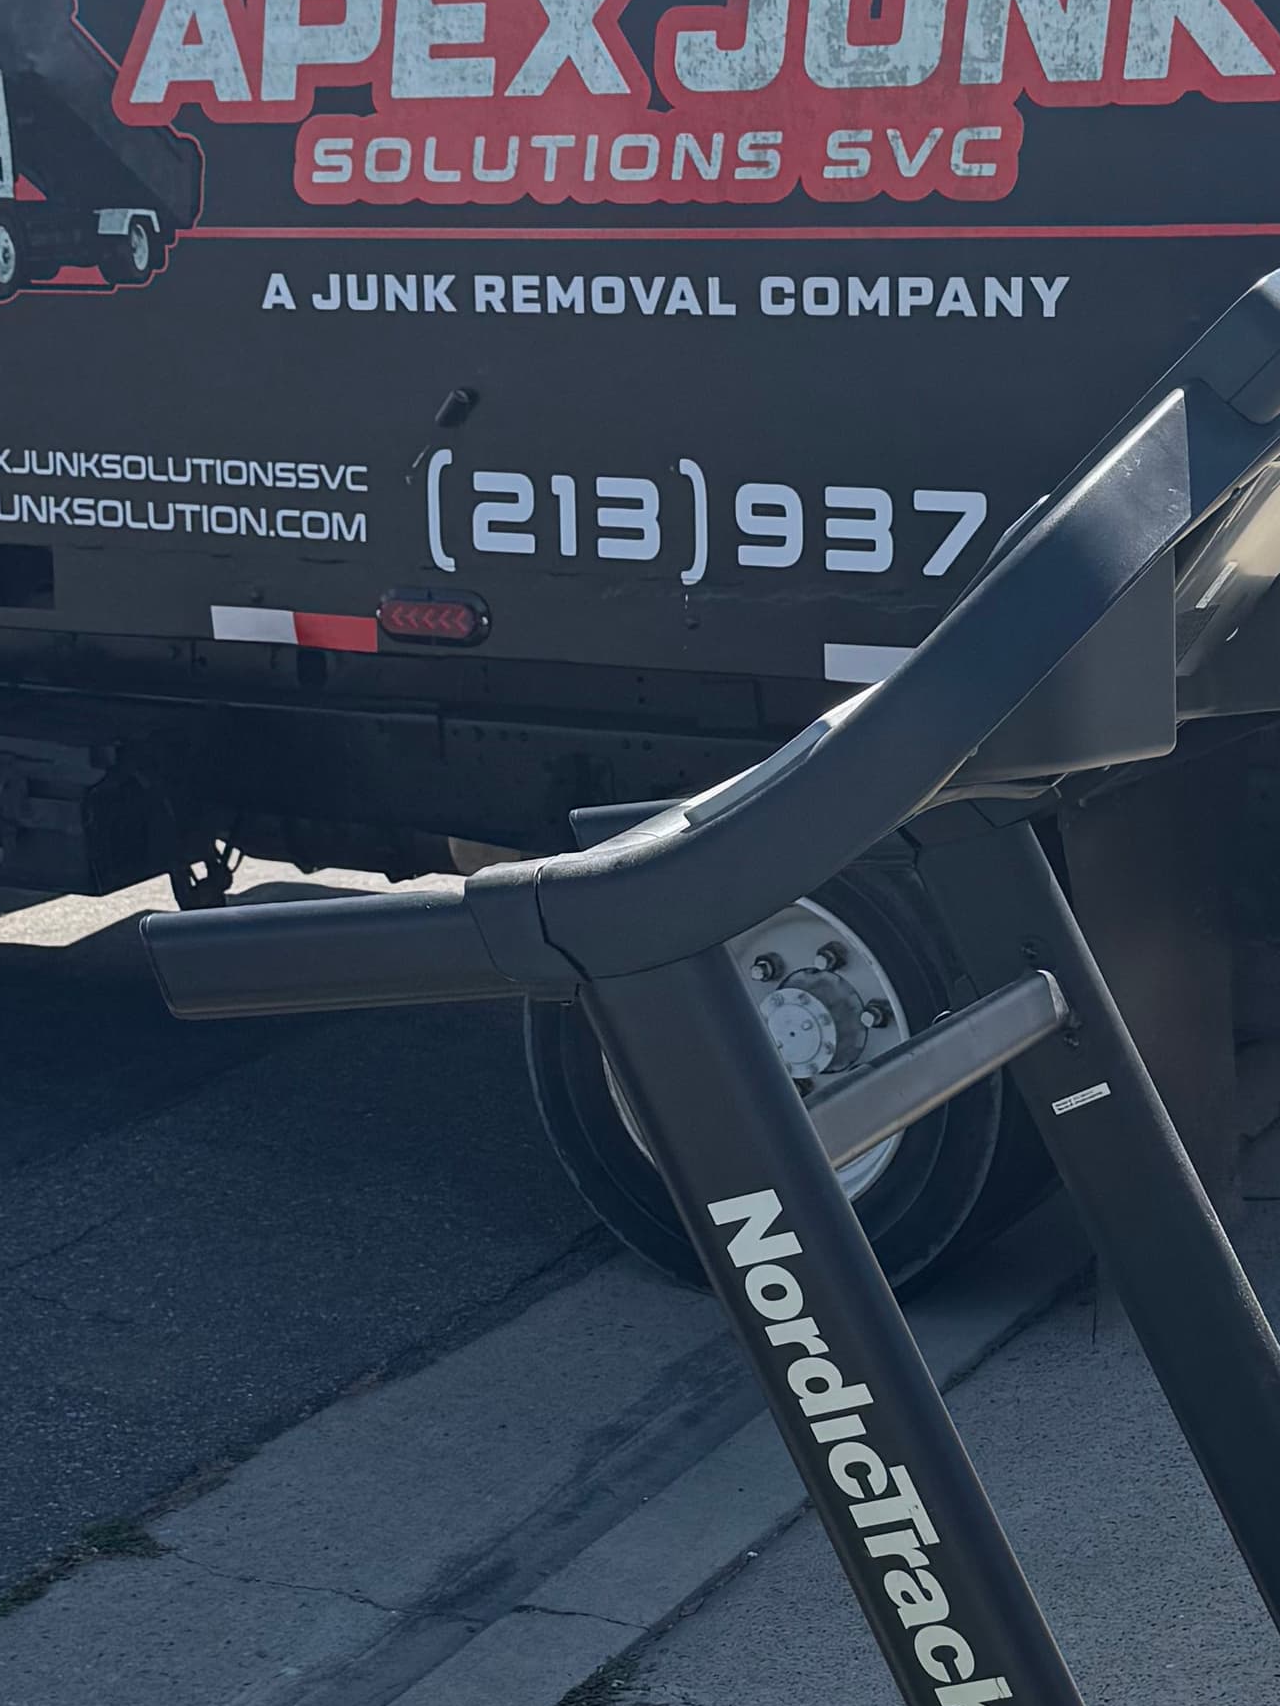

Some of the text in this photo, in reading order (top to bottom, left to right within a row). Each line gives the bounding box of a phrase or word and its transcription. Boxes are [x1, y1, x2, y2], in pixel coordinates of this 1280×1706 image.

[312, 126, 1002, 183] SOLUTIONS SVC
[262, 273, 1070, 319] A JUNK REMOVAL COMPANY
